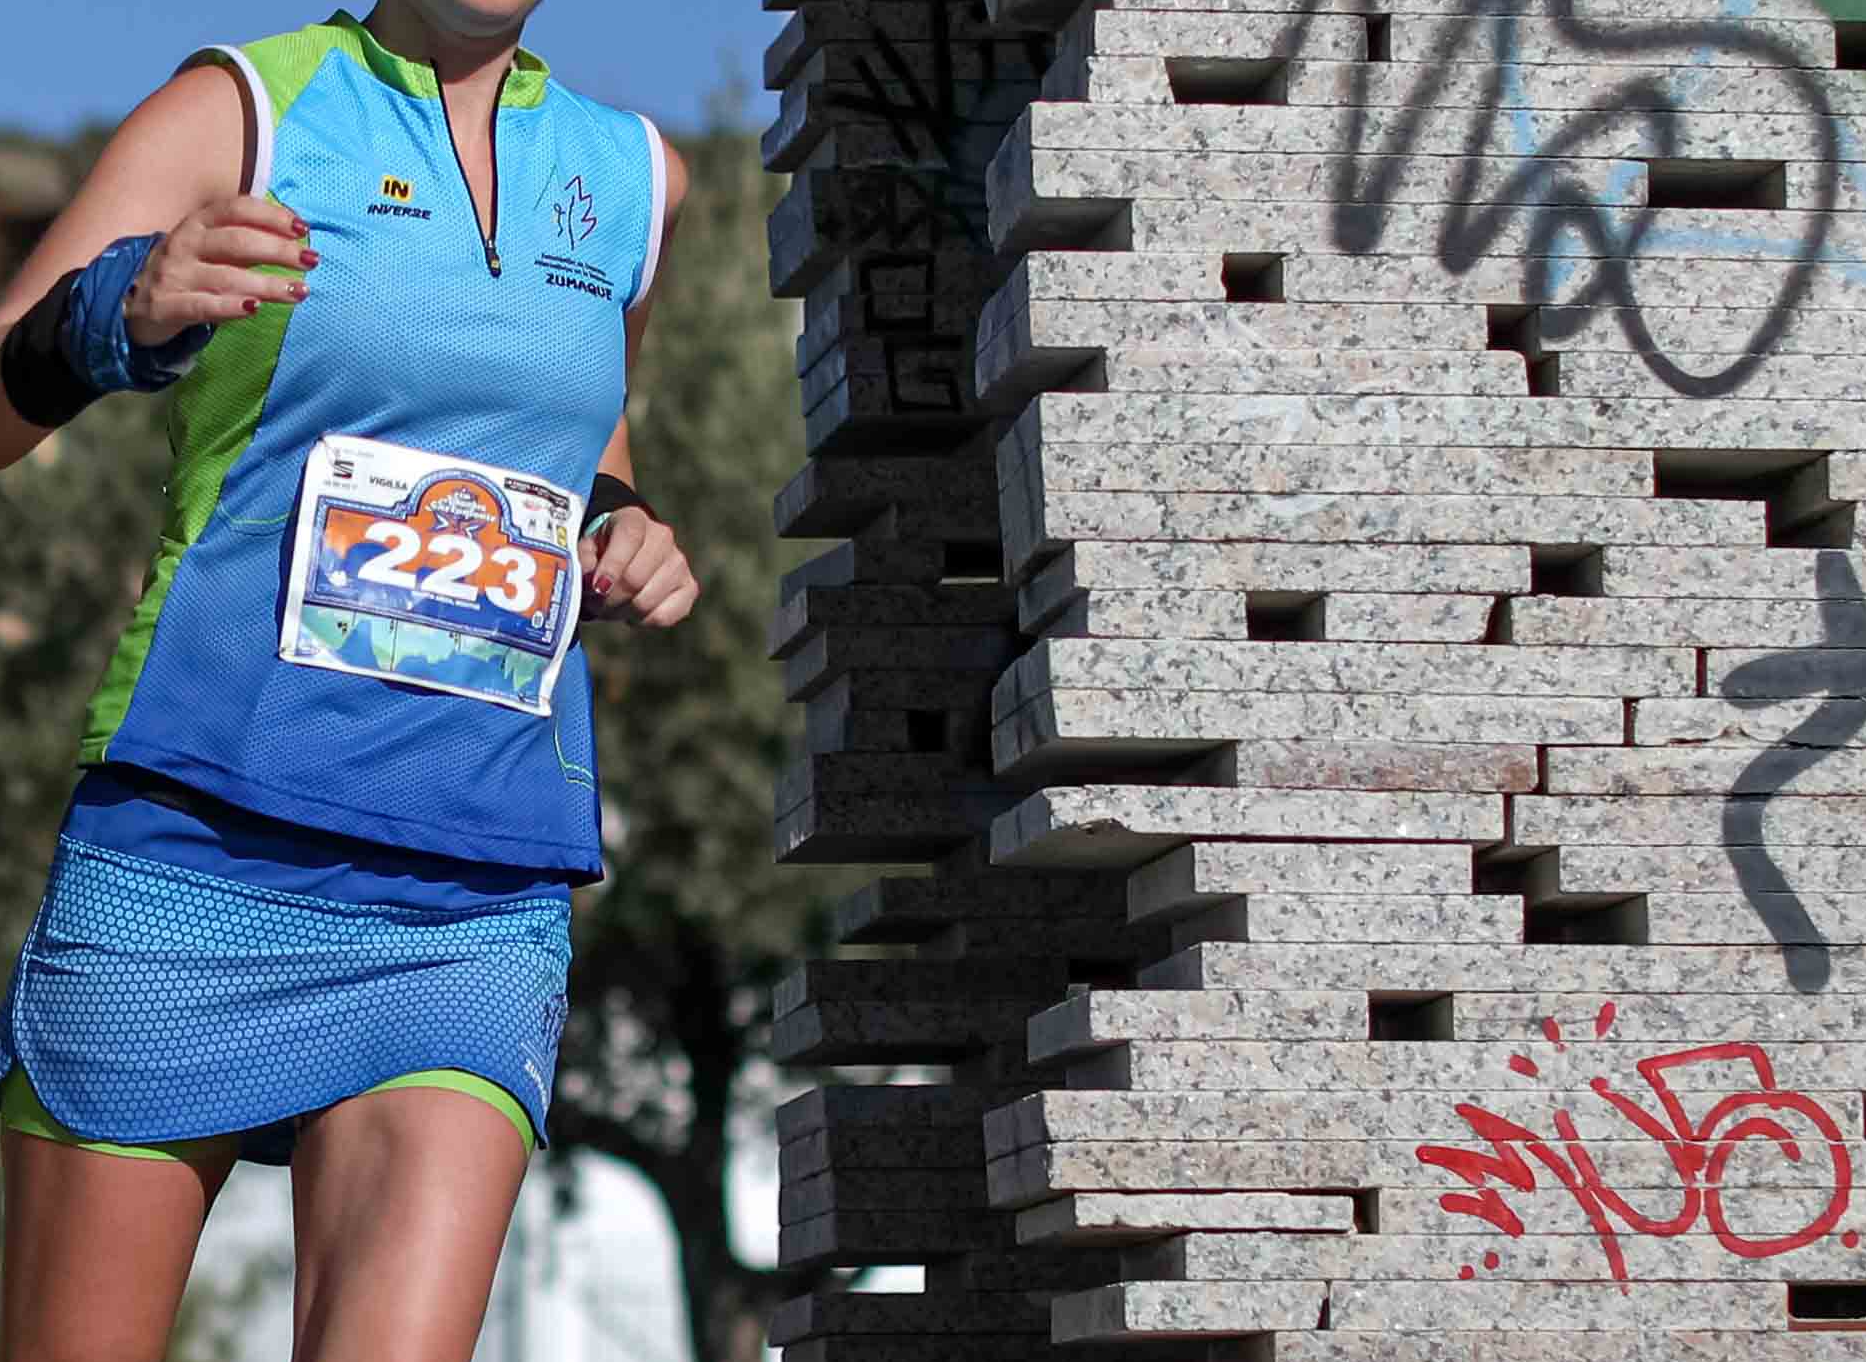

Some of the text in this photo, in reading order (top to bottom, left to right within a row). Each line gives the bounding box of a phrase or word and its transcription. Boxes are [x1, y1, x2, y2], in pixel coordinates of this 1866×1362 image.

[383, 179, 409, 198] IN
[366, 203, 433, 221] INVERSE
[545, 271, 614, 301] ZUMAQUE
[357, 520, 536, 617] 223
